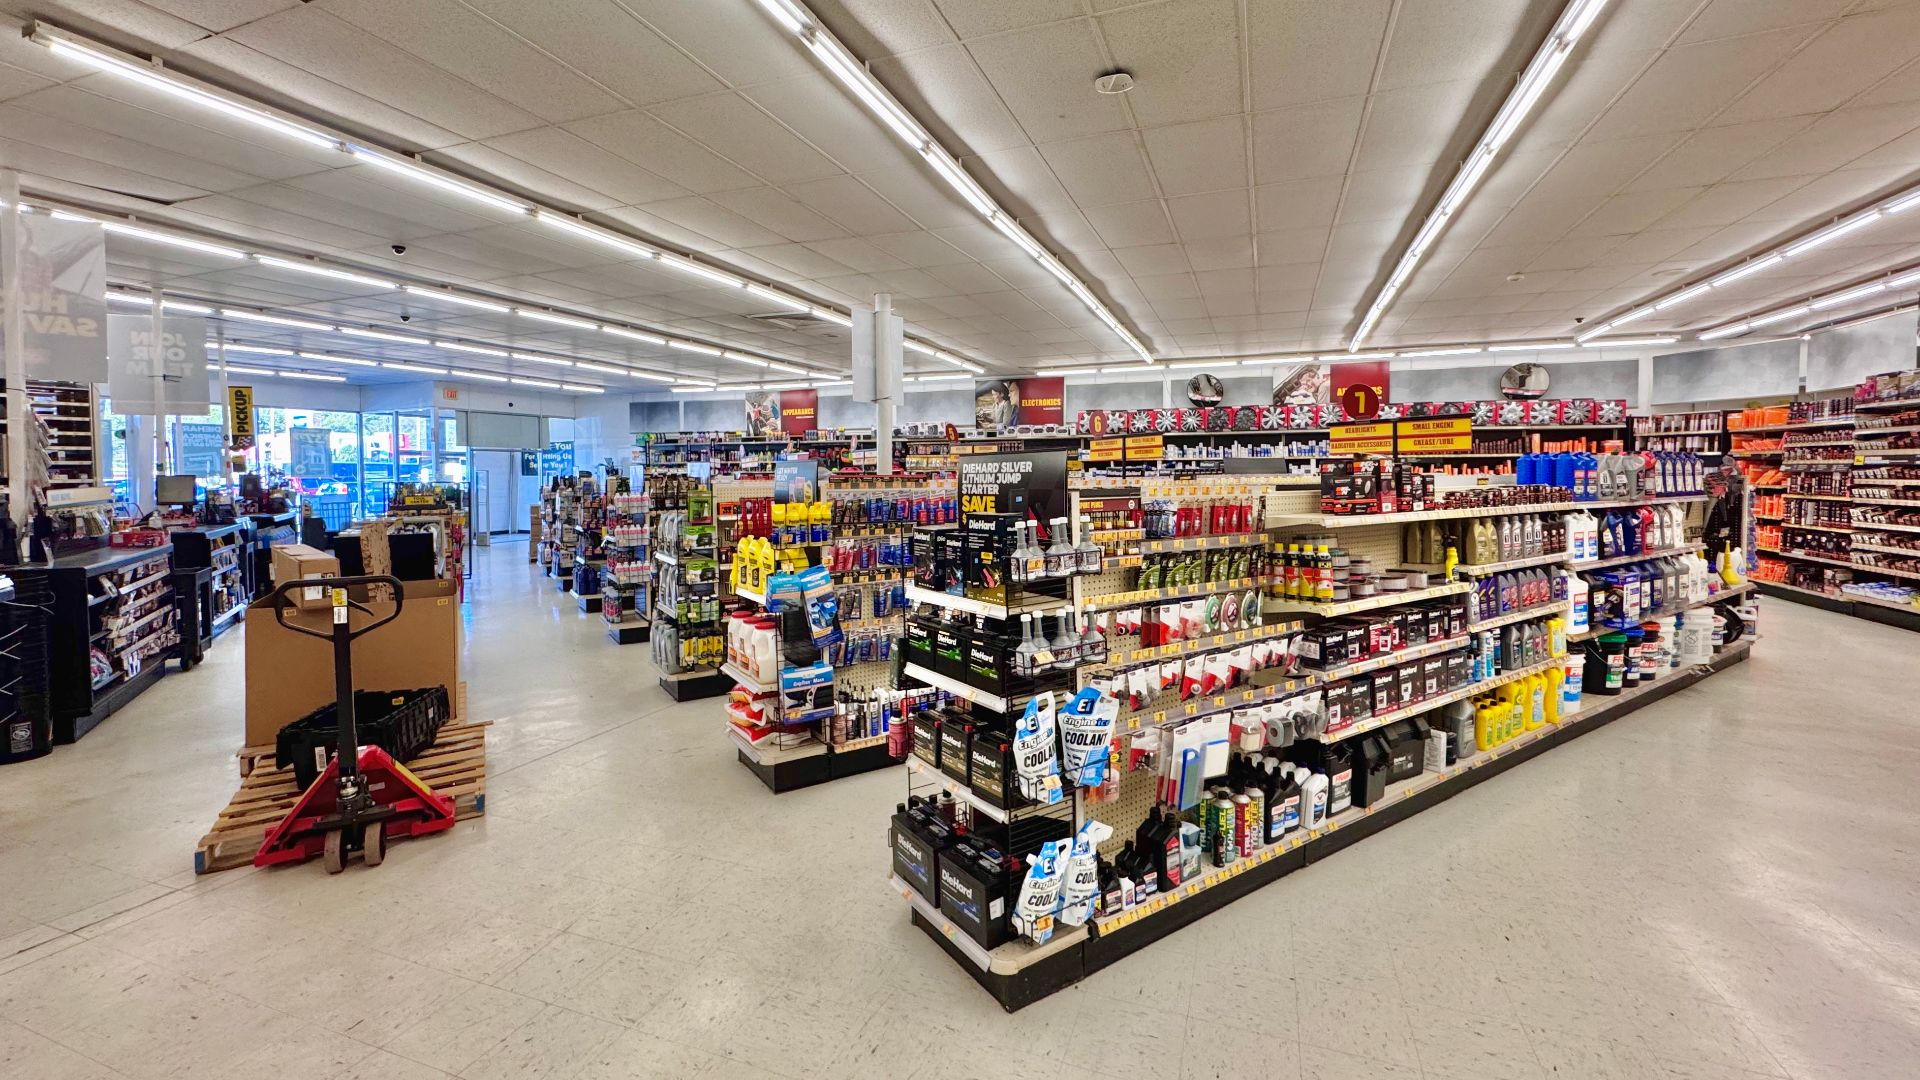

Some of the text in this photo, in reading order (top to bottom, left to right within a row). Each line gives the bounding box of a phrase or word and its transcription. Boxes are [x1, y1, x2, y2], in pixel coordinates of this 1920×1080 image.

[1021, 398, 1062, 407] ELECTRONICS
[1354, 391, 1366, 414] 7
[234, 389, 250, 433] PICKUP
[782, 407, 815, 416] APPEARANCE
[1094, 415, 1102, 433] 6
[1344, 426, 1377, 434] HEADLIGHTS
[1412, 421, 1455, 430] SMALL ENGINE
[948, 426, 956, 439] 5
[555, 442, 572, 450] You
[1330, 440, 1392, 450] RADIATOR ACCESSORIES
[962, 460, 1033, 474] DIEHARD SILVER
[962, 472, 1022, 484] LITHIUM JUMP
[961, 483, 999, 495] STARTER
[961, 495, 996, 513] SAVE
[962, 513, 967, 525] $
[968, 519, 996, 531] DieHard
[914, 531, 931, 542] DieHard
[909, 625, 927, 638] DieHard
[937, 633, 957, 646] DieHard
[970, 648, 994, 663] DieHard
[1399, 665, 1418, 677] DieHard
[1327, 685, 1347, 697] DieHard
[914, 725, 931, 740] DieHard
[1065, 731, 1108, 747] COOLANT
[942, 732, 962, 748] DieHard
[972, 750, 996, 768] DieHard
[1024, 743, 1056, 768] COOLA
[897, 833, 922, 861] DieHard
[941, 868, 973, 900] DieHard
[1028, 890, 1058, 907] COOL
